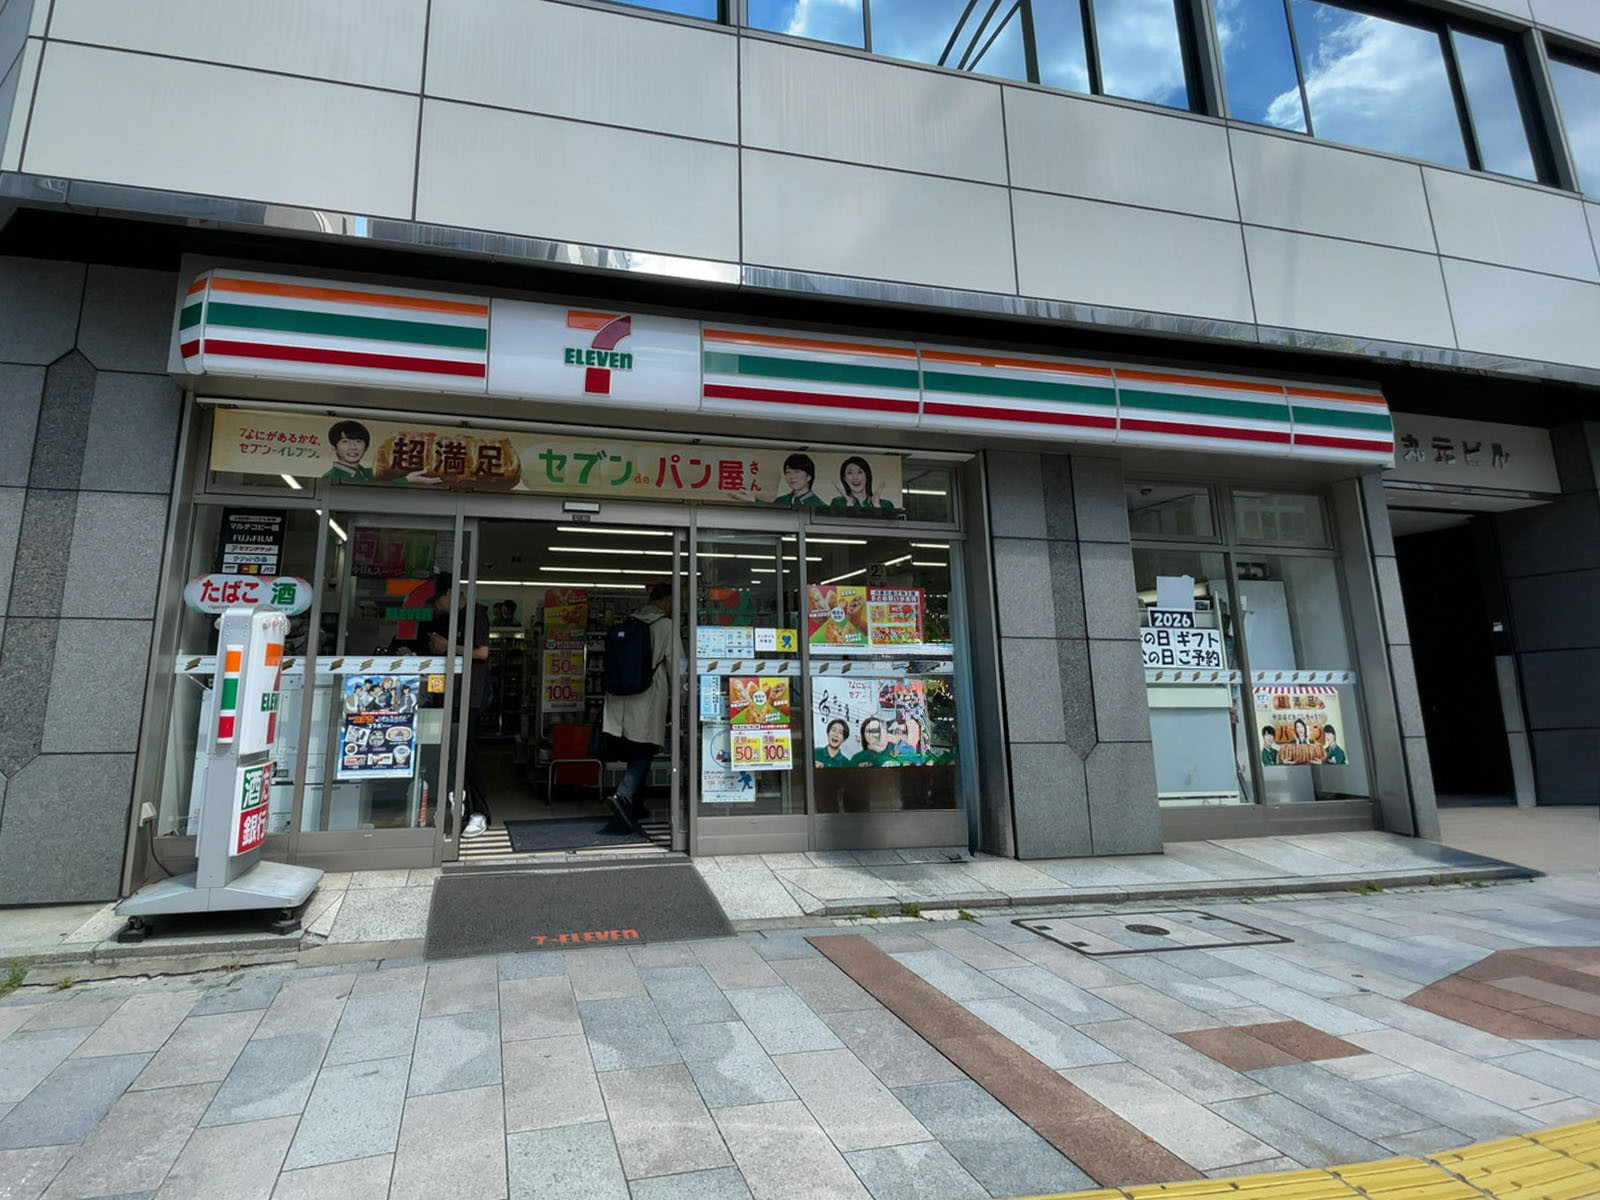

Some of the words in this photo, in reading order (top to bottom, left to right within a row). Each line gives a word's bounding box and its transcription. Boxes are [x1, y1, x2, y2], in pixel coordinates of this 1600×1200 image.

[567, 309, 632, 395] 7
[391, 436, 505, 478] 超満足
[199, 579, 260, 604] たばこ
[270, 582, 298, 606] 酒
[1153, 612, 1191, 627] 2026
[1140, 629, 1171, 647] の日
[1176, 630, 1220, 648] ギフト
[1178, 649, 1221, 668] ご予約
[763, 744, 785, 760] 100
[242, 770, 262, 809] 酒
